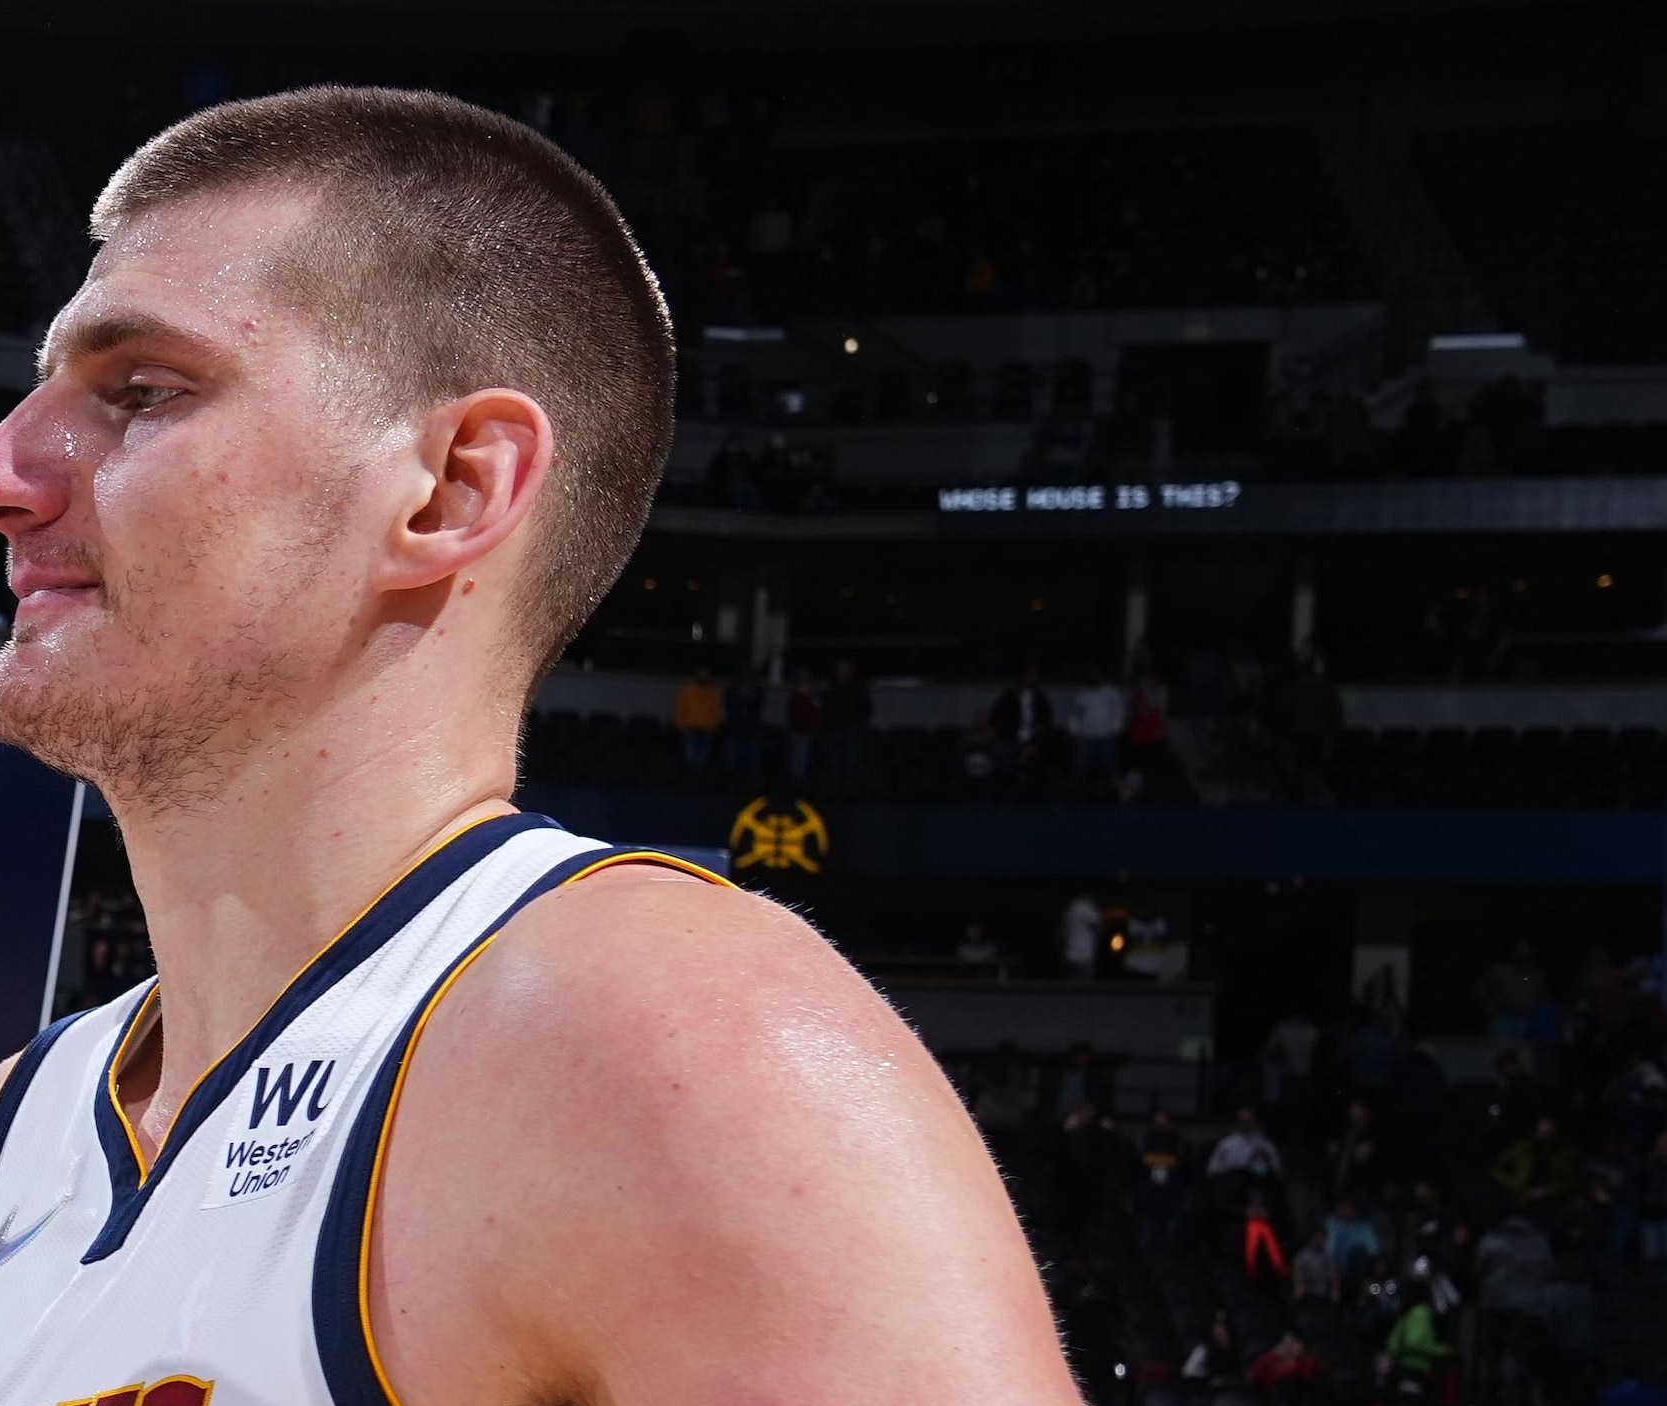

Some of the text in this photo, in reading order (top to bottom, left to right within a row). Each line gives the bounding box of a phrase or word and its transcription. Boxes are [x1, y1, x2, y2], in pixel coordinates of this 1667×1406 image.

[938, 480, 1241, 511] WHOSE HOUSE IS THIS?
[229, 1165, 291, 1197] Union
